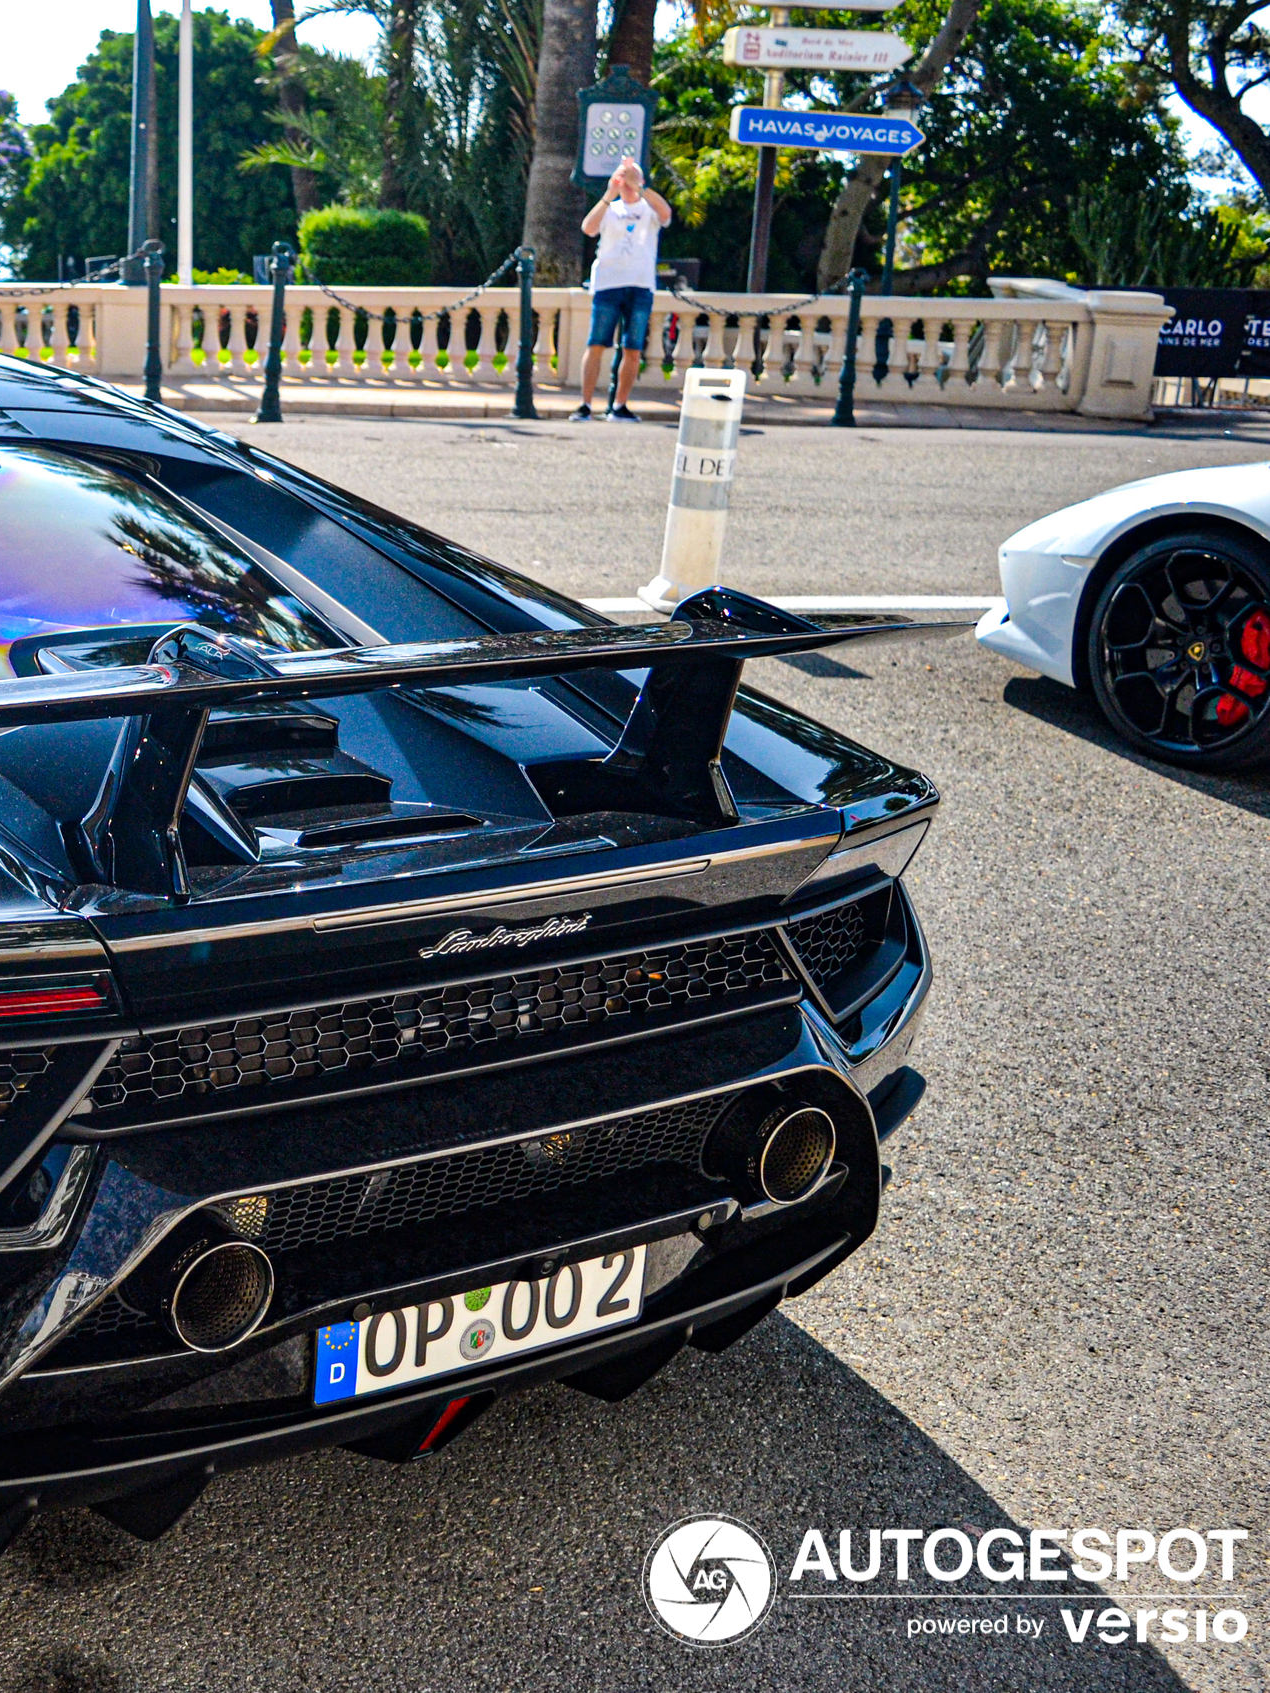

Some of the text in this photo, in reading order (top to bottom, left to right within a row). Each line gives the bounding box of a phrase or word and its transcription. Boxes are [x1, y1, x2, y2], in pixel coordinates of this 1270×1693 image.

[766, 49, 890, 63] Auditorium Rainier III
[748, 118, 912, 144] HAVAS VOYAGES
[699, 457, 725, 477] DE
[197, 645, 224, 661] ALA
[418, 911, 593, 959] Lamborghini
[365, 1296, 455, 1378] OP
[329, 1362, 346, 1385] D
